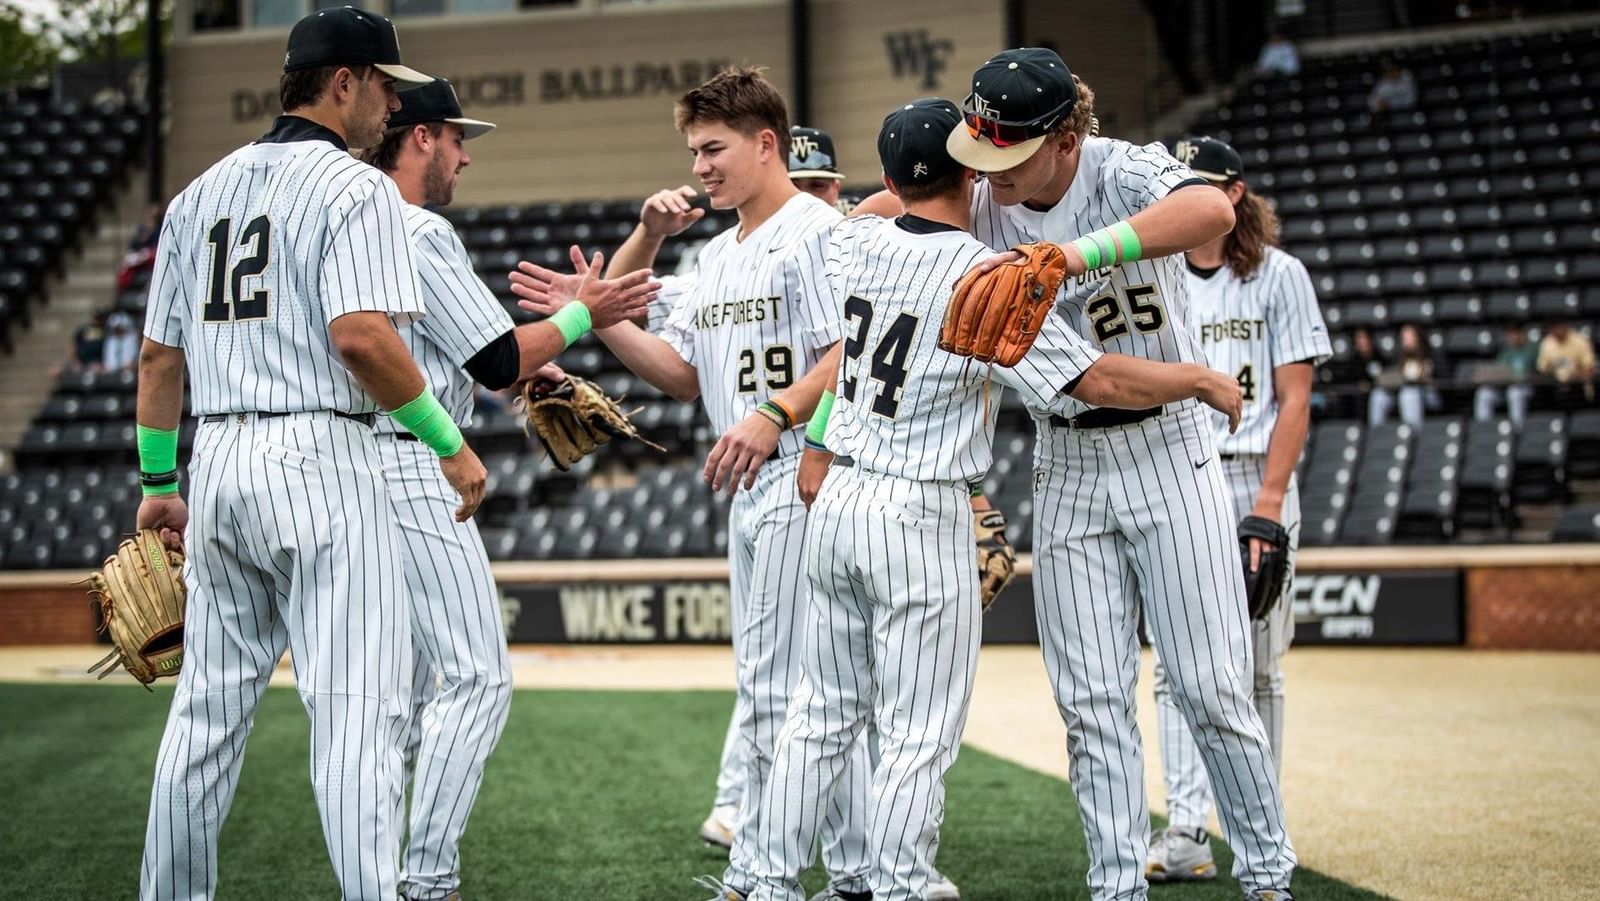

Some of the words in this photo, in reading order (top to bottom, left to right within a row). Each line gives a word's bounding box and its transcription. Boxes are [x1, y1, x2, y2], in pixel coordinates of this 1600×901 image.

[882, 29, 956, 91] WF
[203, 214, 271, 323] 12
[721, 296, 782, 325] FOREST
[1083, 282, 1166, 346] 25
[1201, 318, 1265, 345] FOREST
[736, 342, 797, 396] 29
[842, 291, 922, 422] 24
[559, 585, 656, 640] WAKE
